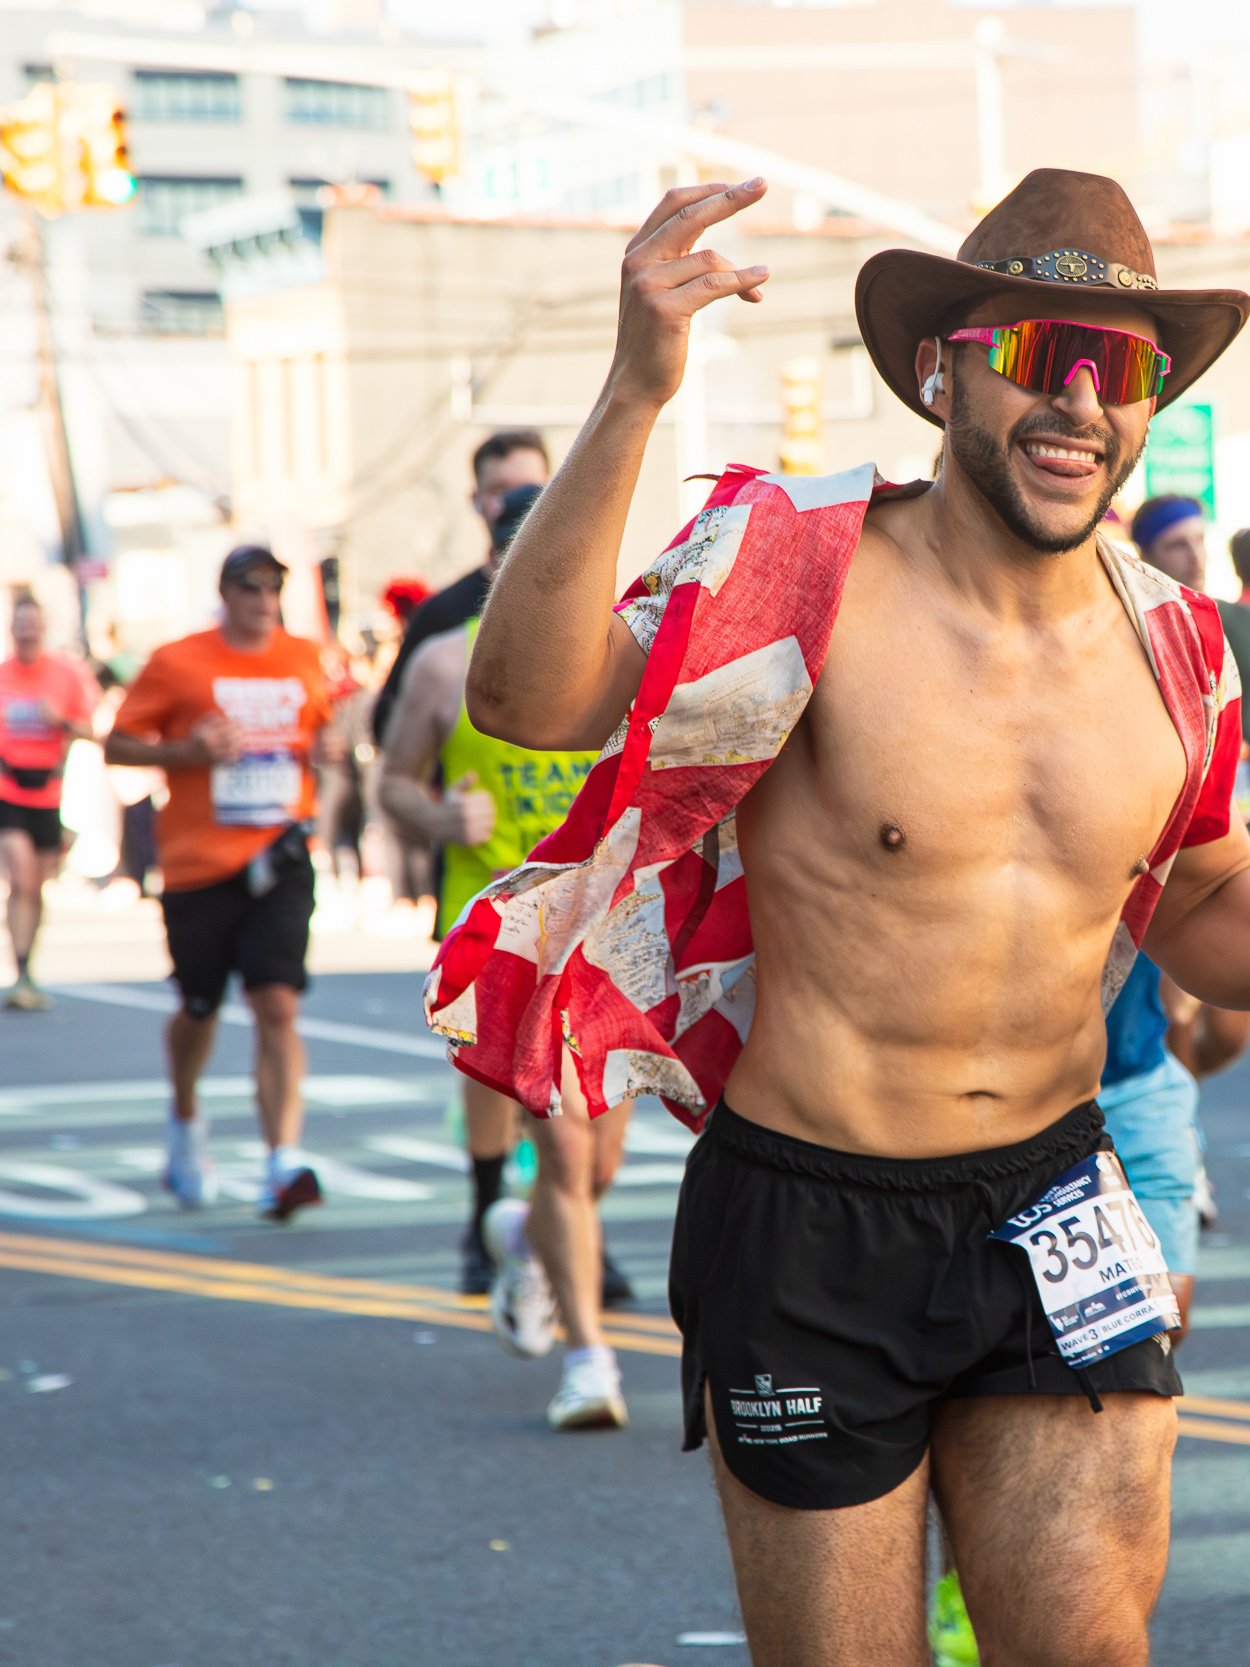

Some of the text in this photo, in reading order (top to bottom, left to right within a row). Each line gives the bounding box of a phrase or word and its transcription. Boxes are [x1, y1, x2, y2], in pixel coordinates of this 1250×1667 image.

[499, 759, 594, 788] TEAM
[1053, 1188, 1085, 1207] SERVICES
[1029, 1198, 1156, 1284] 35476
[1061, 1335, 1087, 1350] WAVE
[1088, 1328, 1099, 1340] 3
[1101, 1320, 1122, 1333] BLUE
[1123, 1303, 1157, 1320] CORRA
[730, 1397, 822, 1417] BROOKLYN HALF
